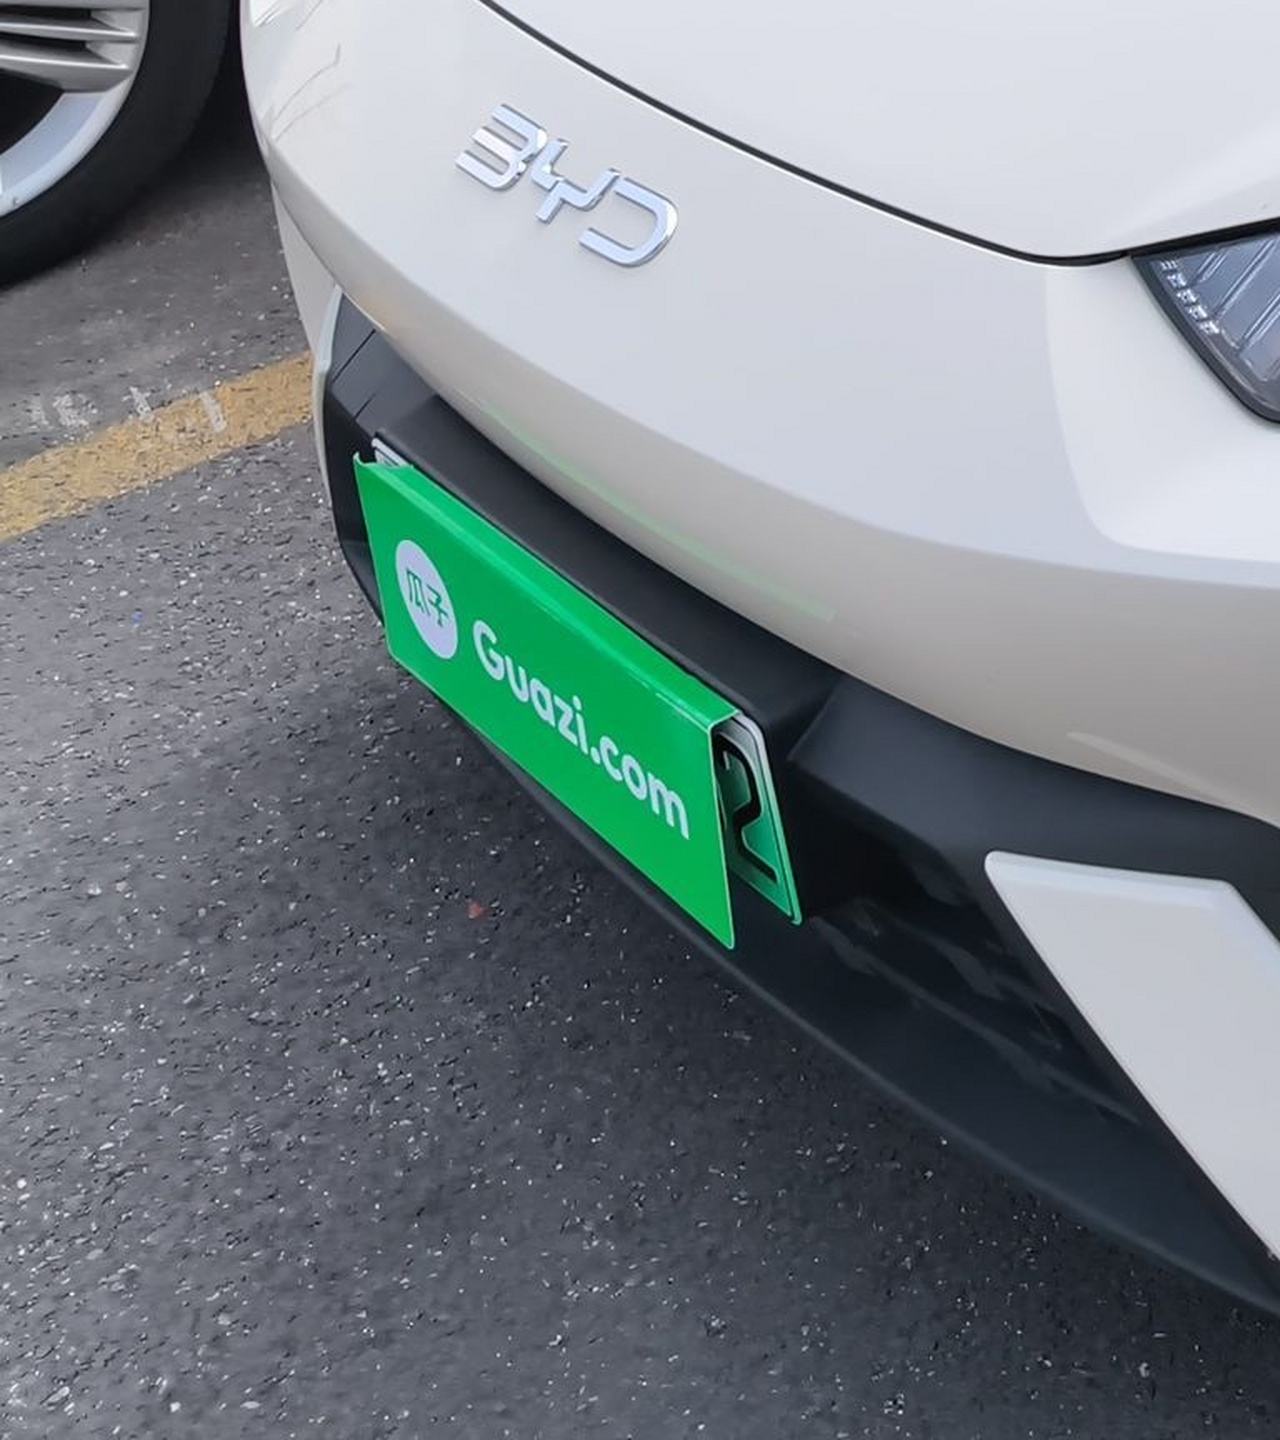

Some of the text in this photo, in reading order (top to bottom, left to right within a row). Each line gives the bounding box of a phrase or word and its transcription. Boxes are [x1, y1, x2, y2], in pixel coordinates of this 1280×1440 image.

[454, 102, 680, 269] BYD
[405, 566, 449, 628] 瓜子
[471, 618, 690, 843] Guazi.com
